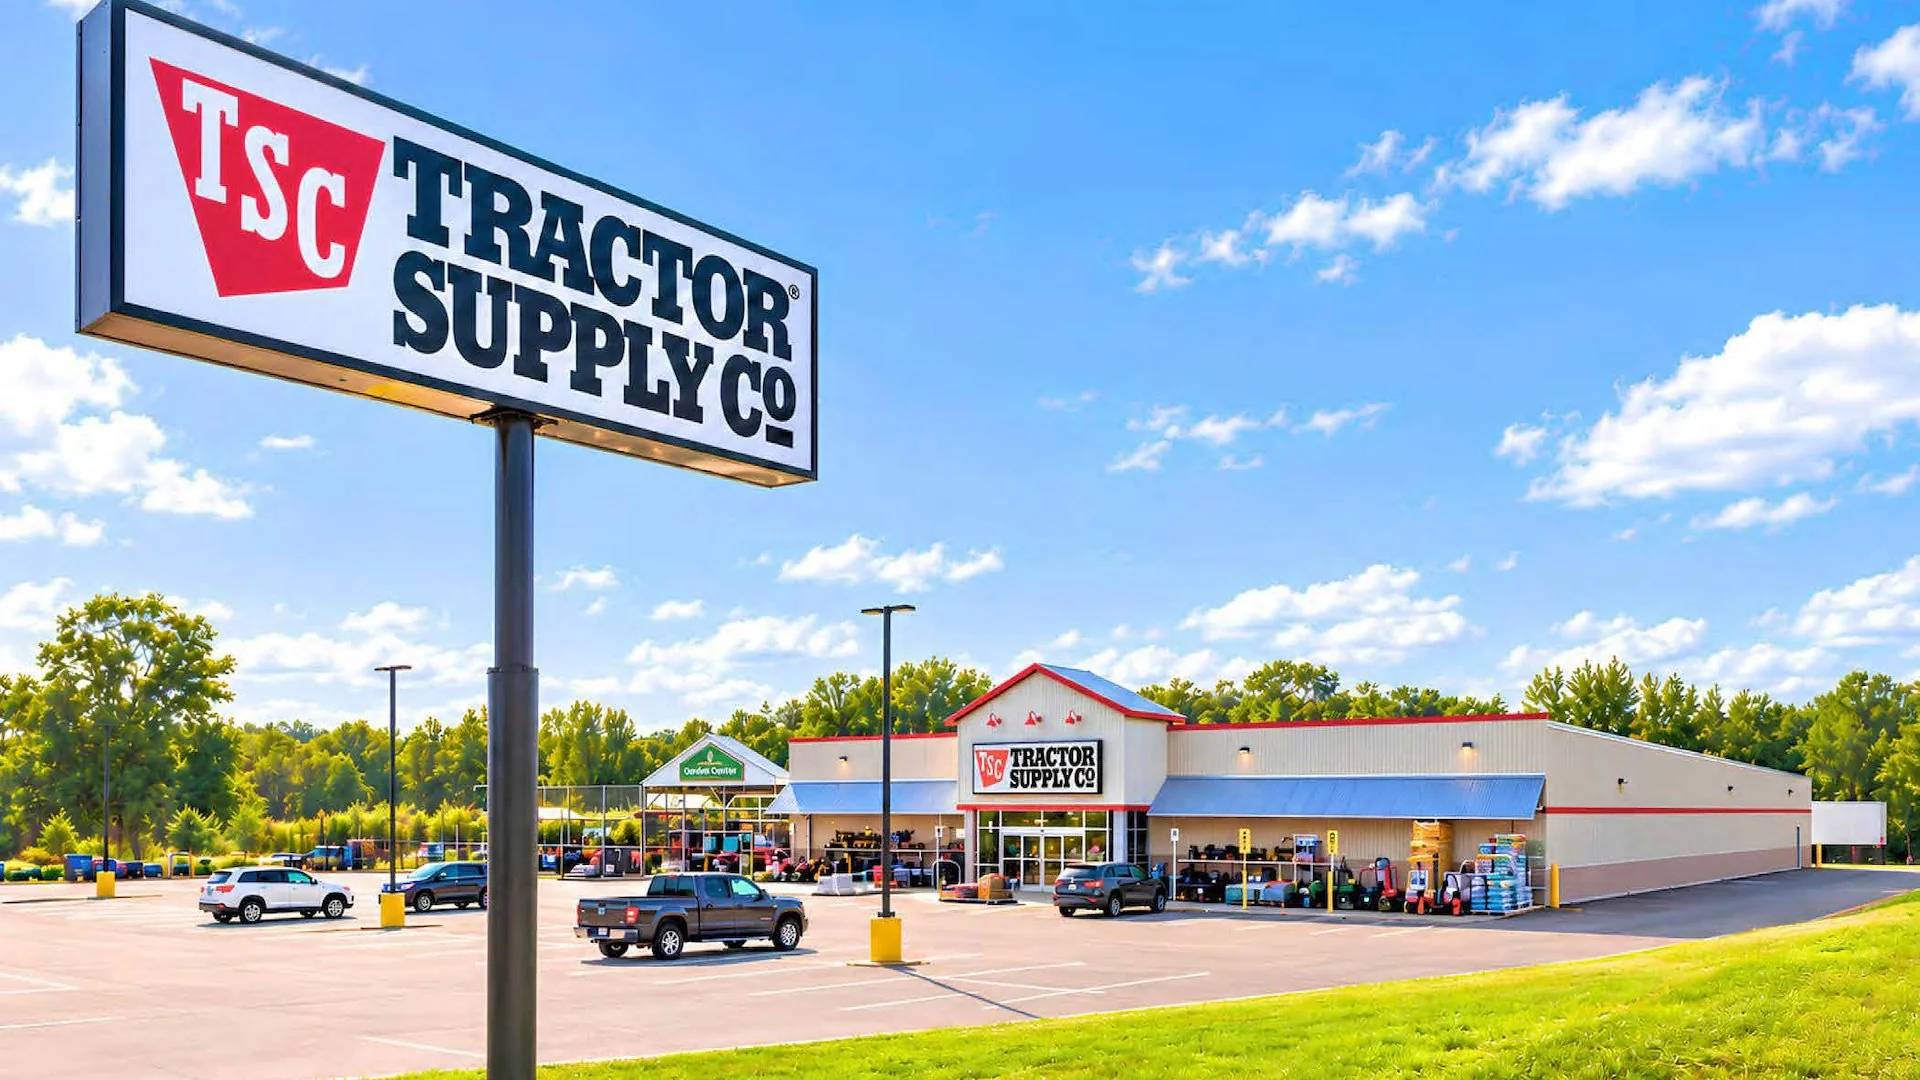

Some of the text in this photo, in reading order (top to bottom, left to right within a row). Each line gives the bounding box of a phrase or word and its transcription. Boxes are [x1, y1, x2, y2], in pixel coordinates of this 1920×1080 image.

[182, 77, 346, 279] TSC
[393, 250, 714, 424] SUPPLY
[979, 751, 1003, 779] TSC
[1010, 746, 1095, 767] TRACTOR
[1010, 768, 1073, 788] SUPPLY
